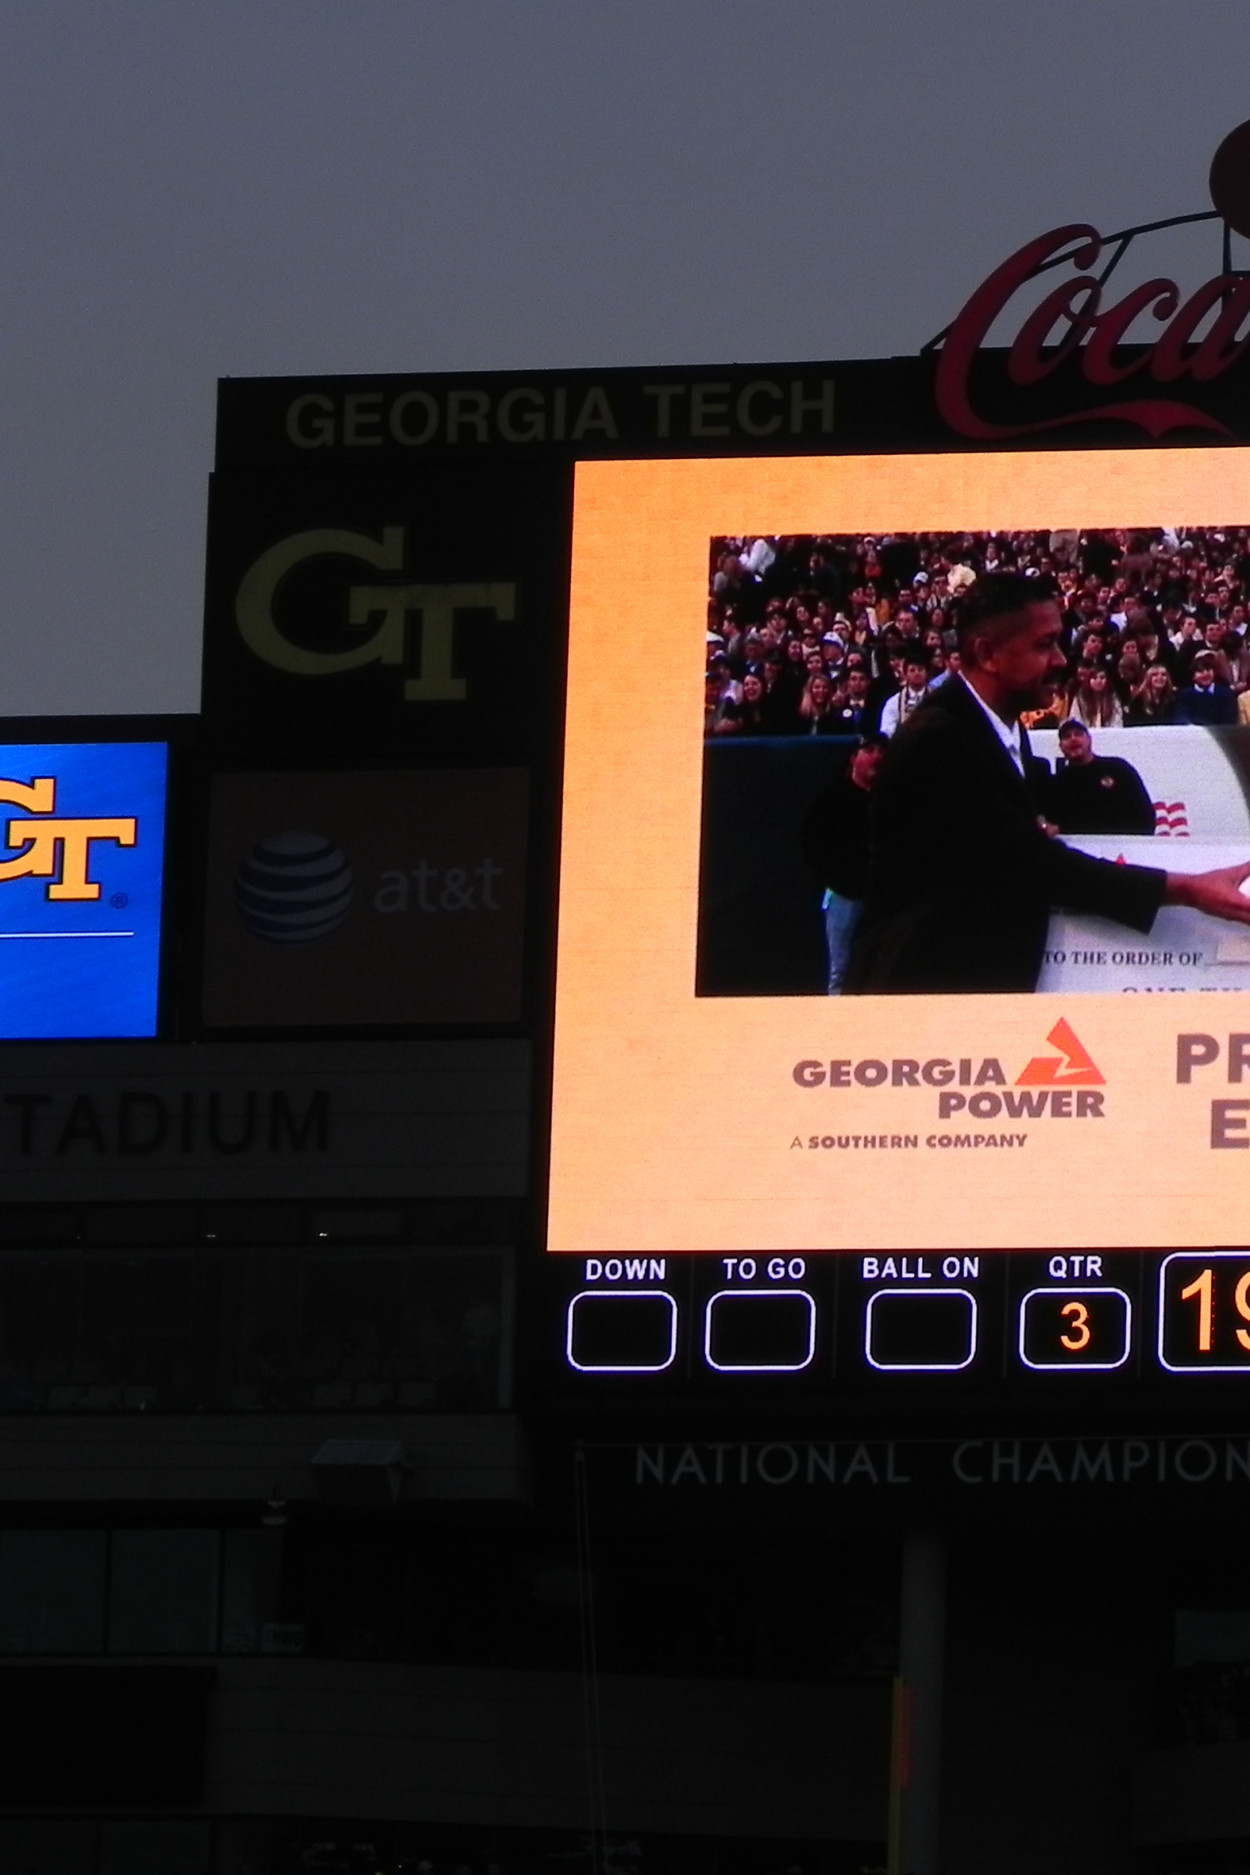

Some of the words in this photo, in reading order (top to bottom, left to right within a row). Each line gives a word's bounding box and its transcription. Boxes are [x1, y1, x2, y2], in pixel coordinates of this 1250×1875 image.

[286, 386, 620, 449] GEORGIA
[643, 379, 837, 439] TECH
[235, 525, 516, 702] GT
[373, 856, 504, 914] at&t
[1043, 951, 1066, 966] TO
[1071, 951, 1107, 966] THE
[1111, 951, 1174, 967] ORDER
[1178, 952, 1204, 967] OF
[792, 1058, 1007, 1087] GEORGIA
[938, 1090, 1105, 1119] POWER
[790, 1136, 803, 1149] A
[808, 1134, 918, 1149] SOUTHERN
[926, 1133, 1028, 1148] COMPANY
[585, 1258, 667, 1281] DOWN
[723, 1258, 760, 1280] TO
[766, 1257, 807, 1280] GO
[862, 1257, 932, 1279] BALL
[942, 1256, 980, 1279] ON
[1048, 1255, 1103, 1278] QTR
[1059, 1302, 1090, 1350] 3
[635, 1443, 911, 1485] NATIONAL
